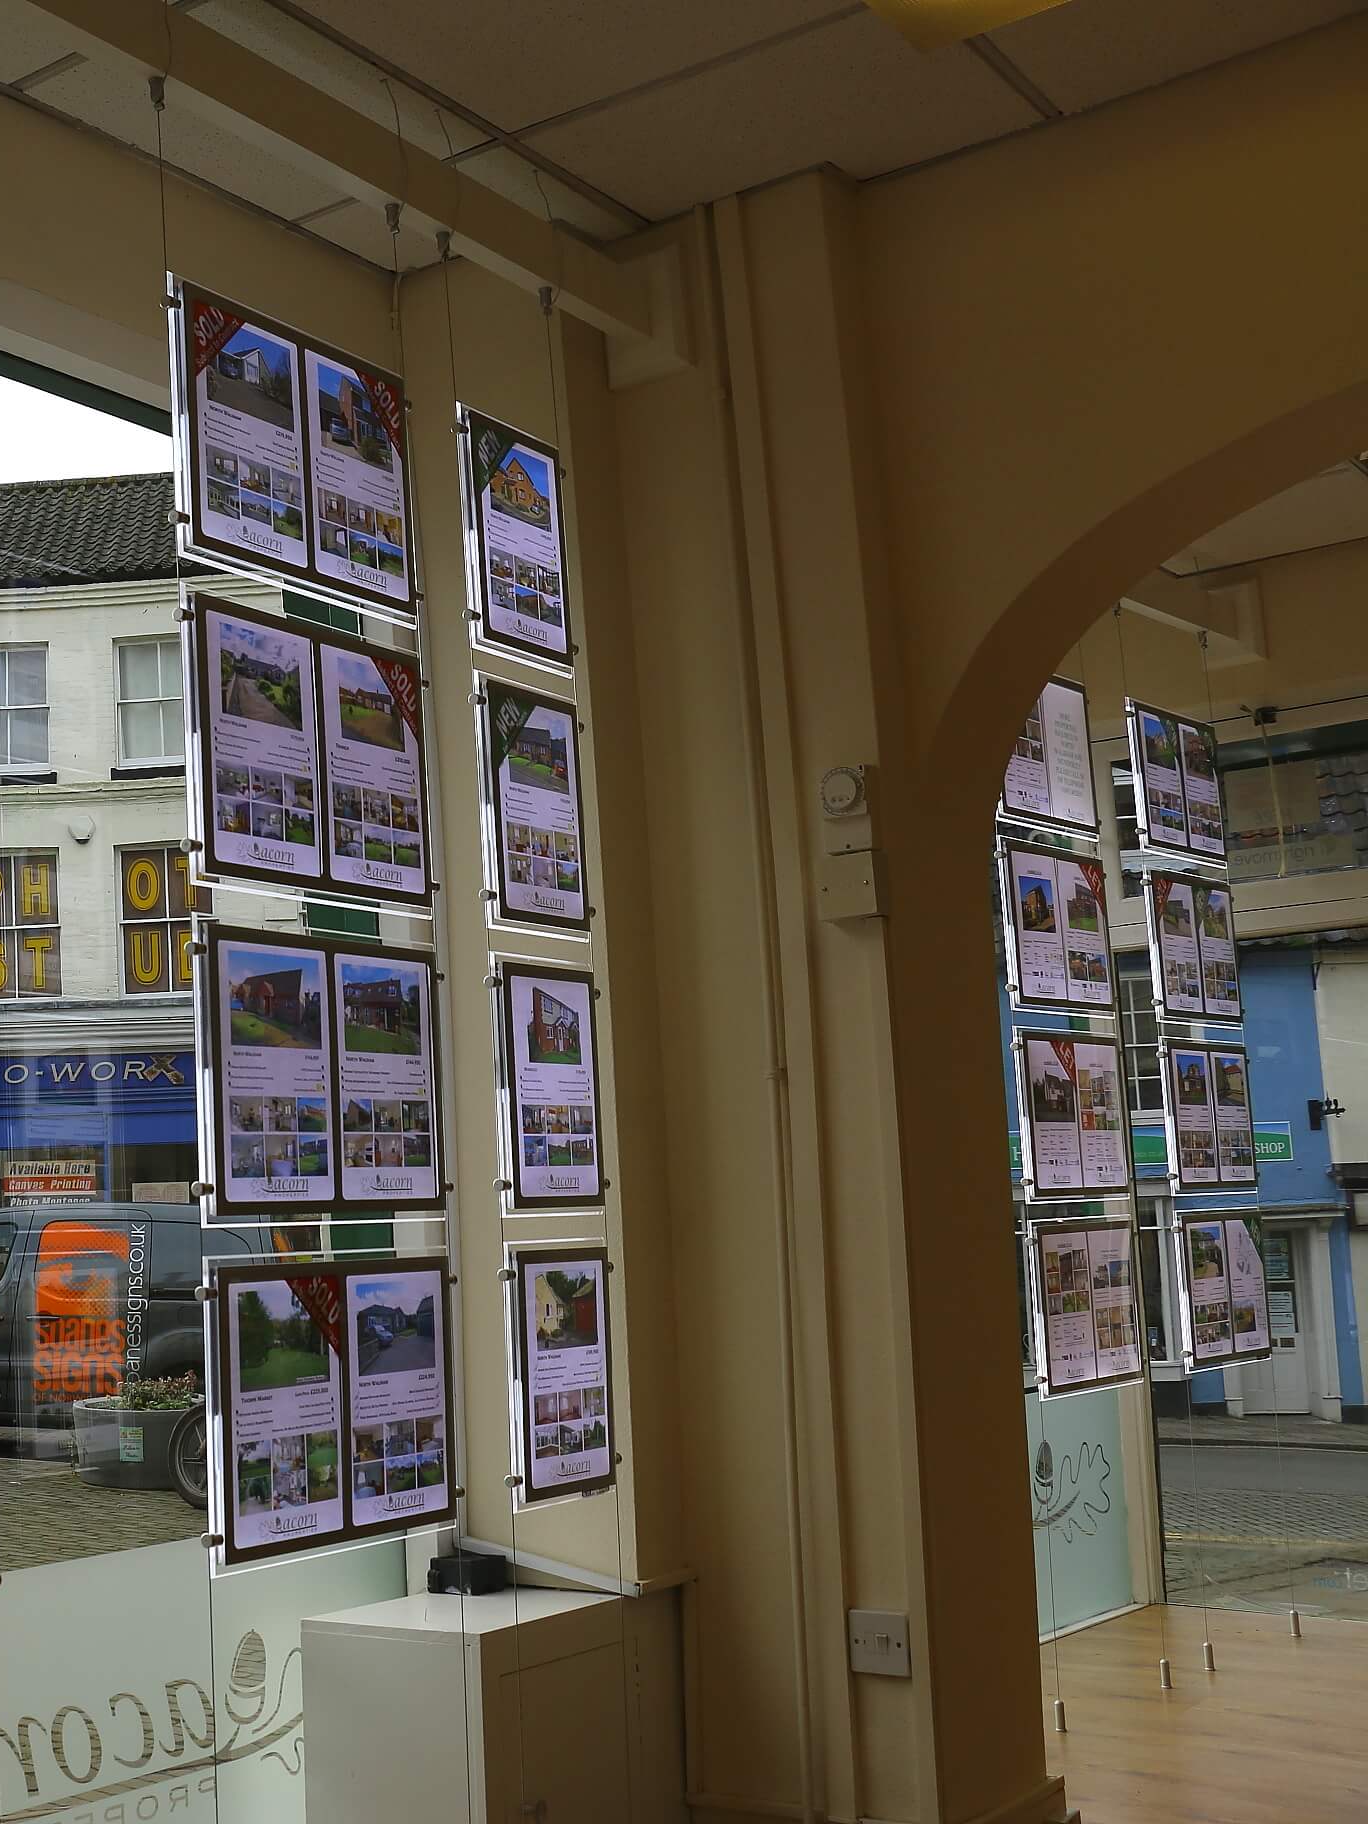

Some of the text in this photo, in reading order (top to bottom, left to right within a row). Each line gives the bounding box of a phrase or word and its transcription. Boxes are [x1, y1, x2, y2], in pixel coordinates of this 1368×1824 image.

[193, 306, 224, 346] SOLD
[374, 381, 400, 429] SOLD
[248, 529, 283, 549] acorn
[357, 567, 388, 586] acorn
[522, 625, 548, 642] acorn
[496, 697, 521, 740] NEW
[260, 847, 295, 864] acorn
[372, 866, 403, 883] acorn
[539, 897, 565, 909] acorn
[1254, 1140, 1285, 1155] SHOP
[10, 1161, 91, 1176] Available Here
[8, 1178, 92, 1192] Canvas Printing
[273, 1177, 309, 1190] acorn
[382, 1175, 413, 1188] acorn
[554, 1175, 580, 1187] acorn
[309, 1276, 340, 1325] SOLD
[565, 1460, 591, 1475] acorn
[393, 1491, 425, 1510] acorn
[282, 1512, 318, 1531] acorn
